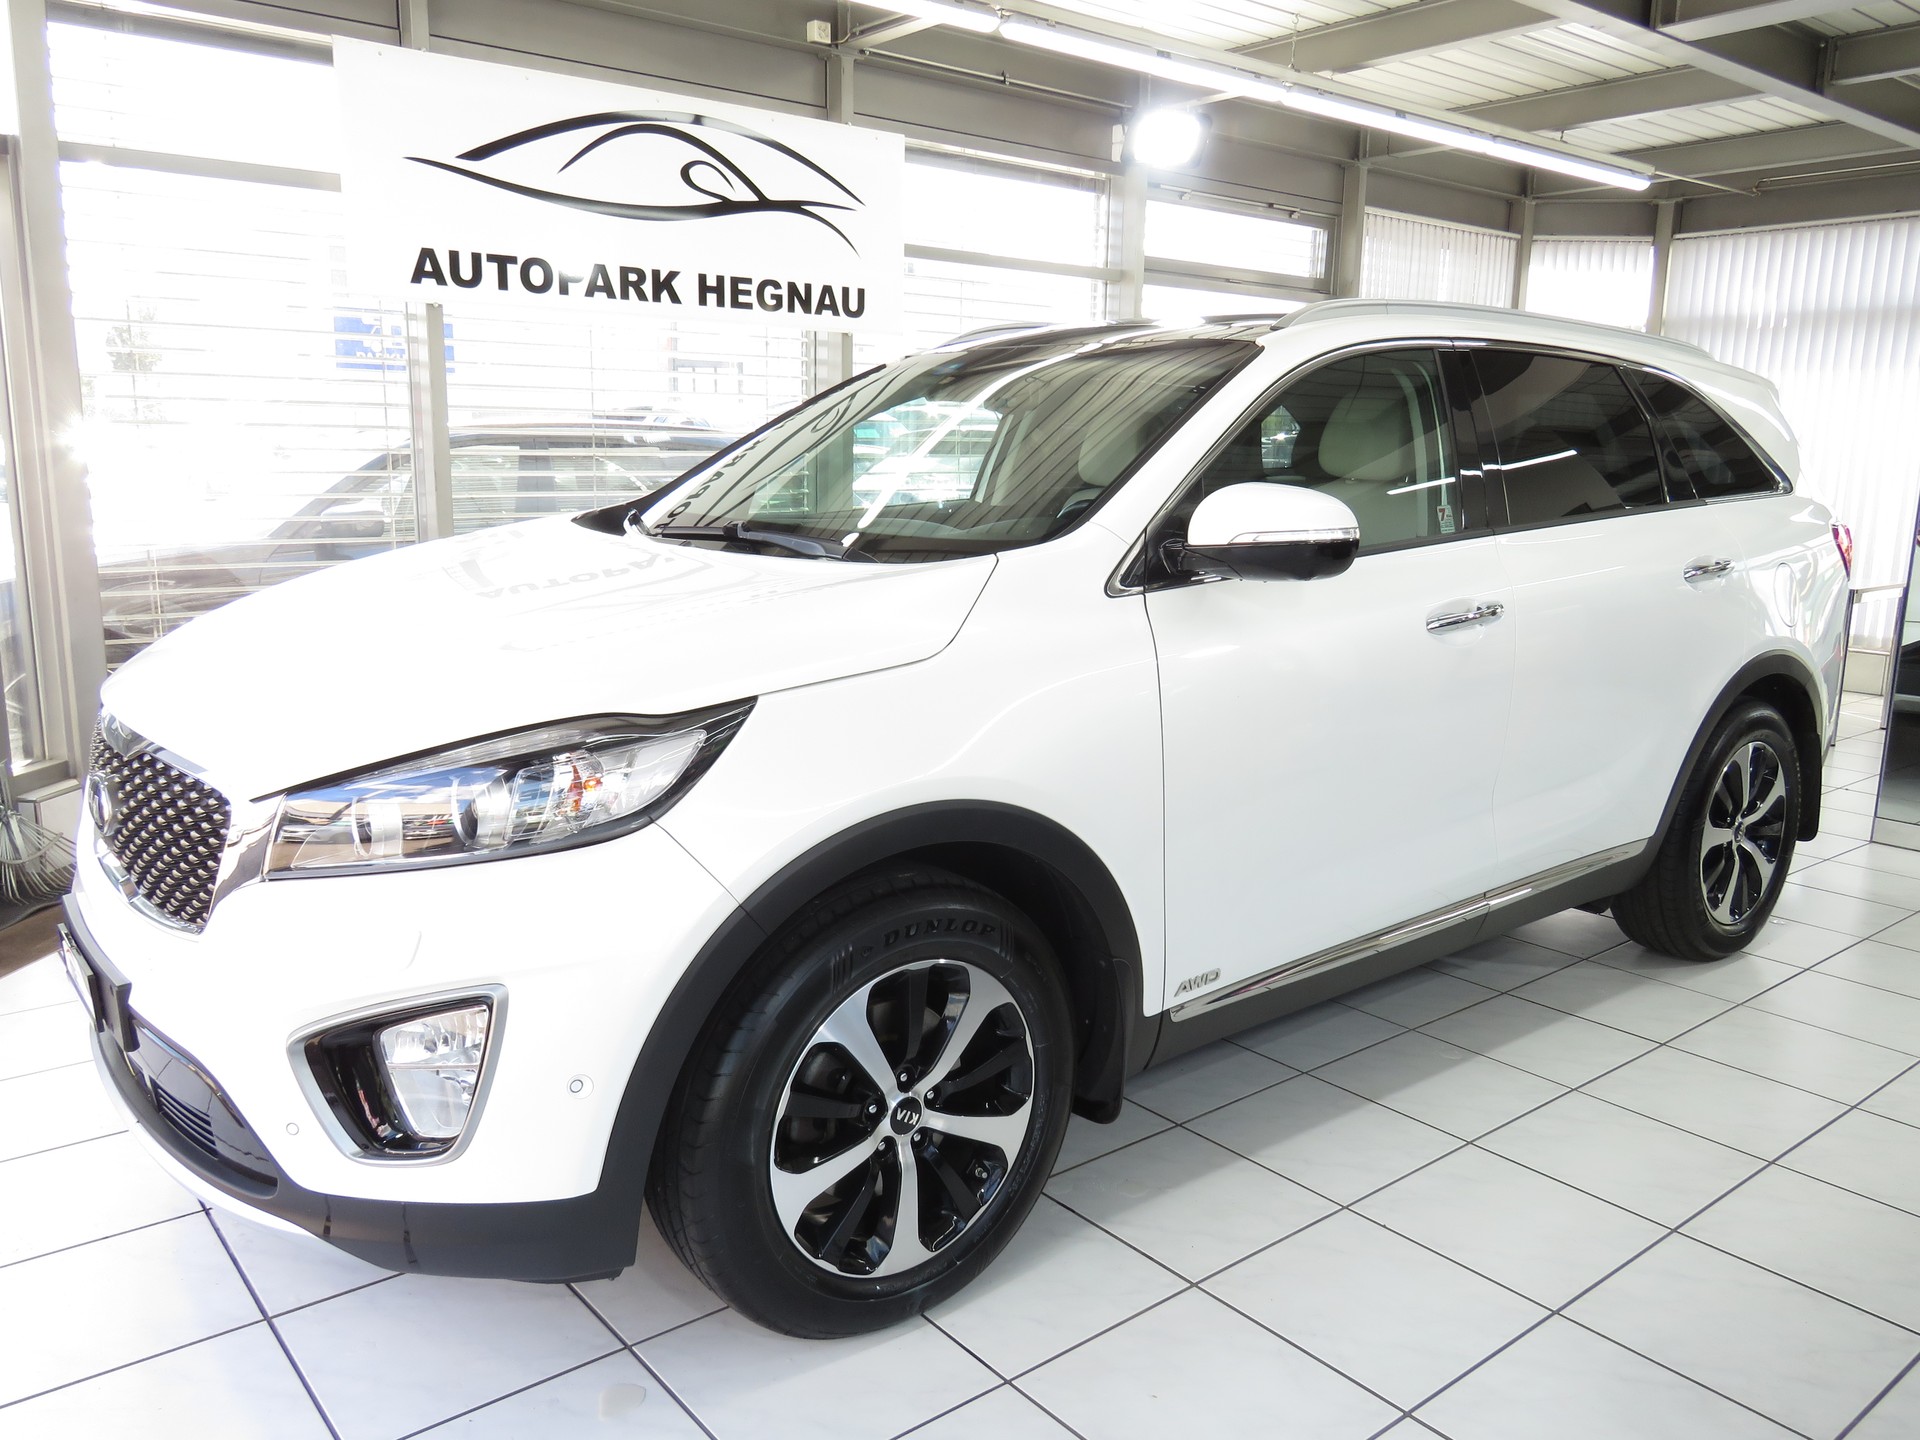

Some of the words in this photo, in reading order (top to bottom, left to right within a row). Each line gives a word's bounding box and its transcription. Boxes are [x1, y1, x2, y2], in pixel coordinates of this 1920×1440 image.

[698, 273, 866, 318] HEGNAU
[884, 918, 996, 946] DUNLOP
[1173, 967, 1221, 997] AWD
[896, 1107, 919, 1126] KIA
